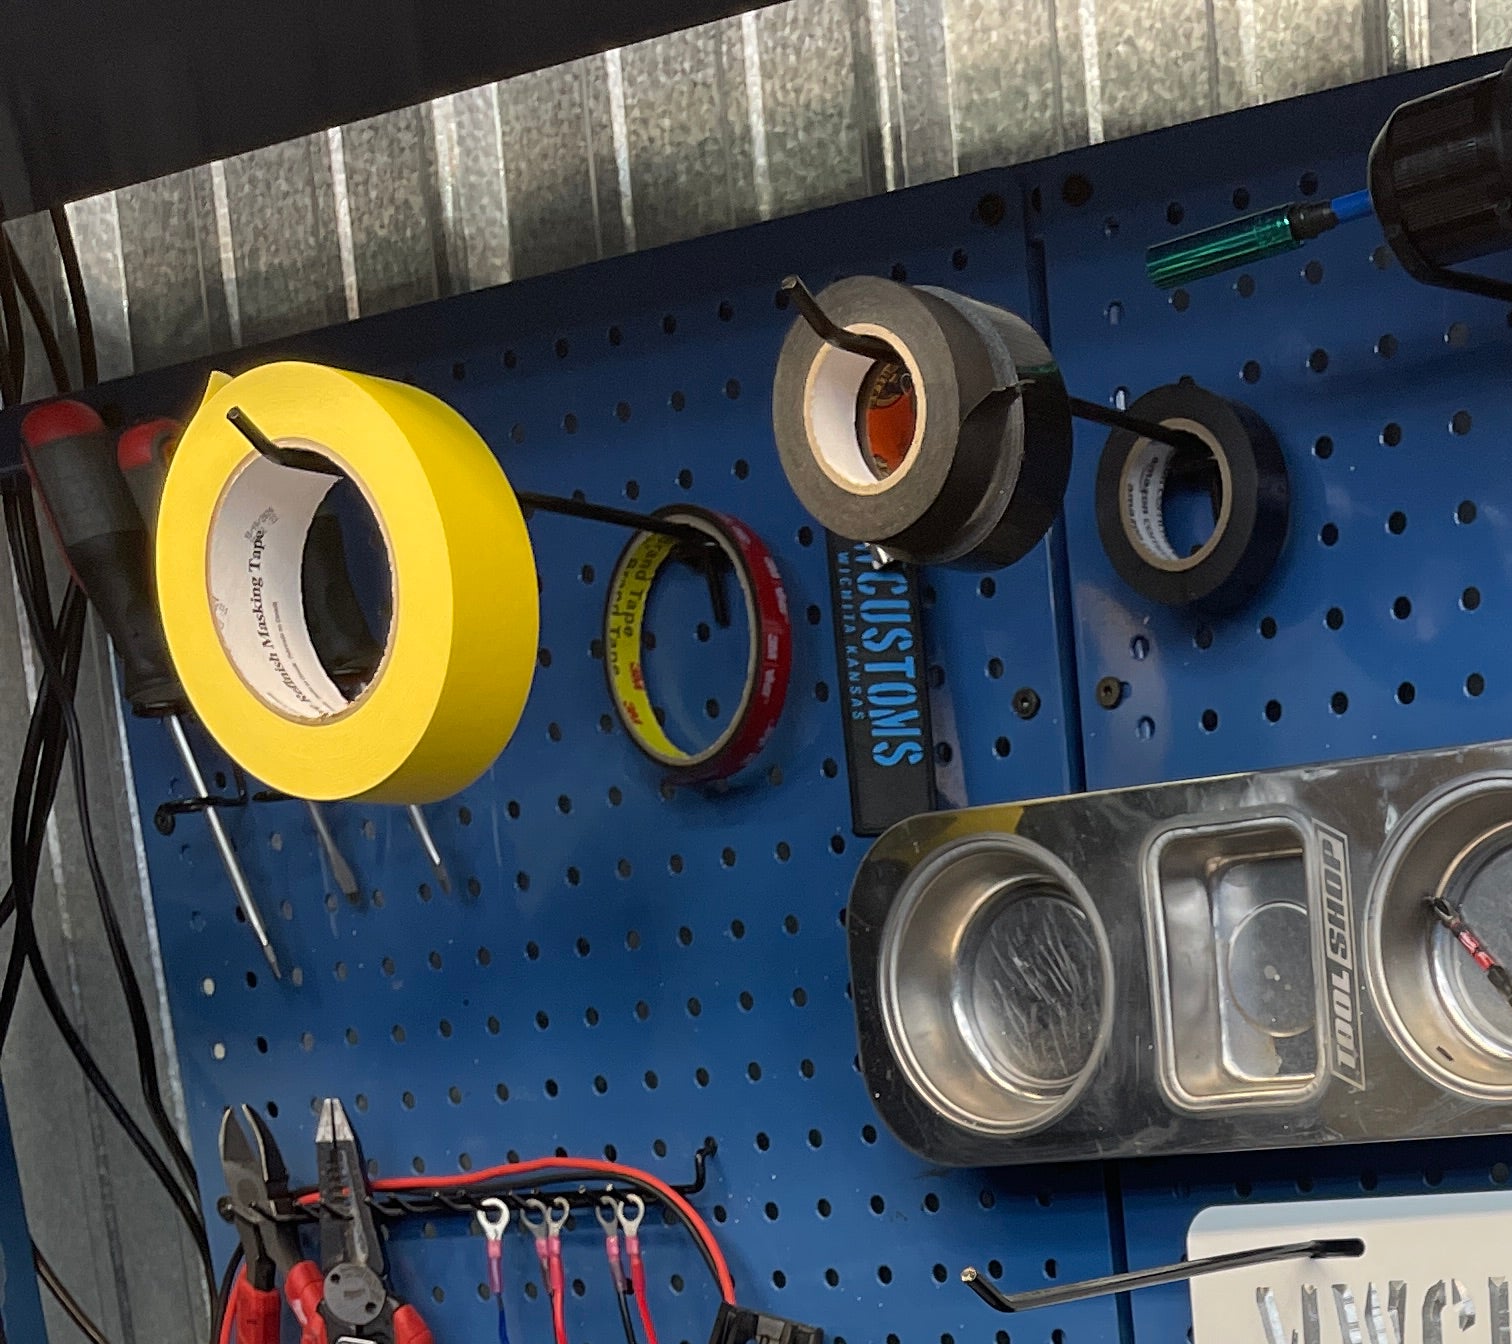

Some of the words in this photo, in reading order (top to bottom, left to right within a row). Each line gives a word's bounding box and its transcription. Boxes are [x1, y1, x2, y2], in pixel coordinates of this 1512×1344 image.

[249, 530, 266, 572] Tape
[251, 577, 275, 650] Masking
[623, 590, 643, 637] Tape
[837, 551, 857, 634] WICHITA
[846, 645, 865, 720] KANSAS
[1322, 839, 1348, 960] SHOP
[1332, 970, 1356, 1068] TOOL
